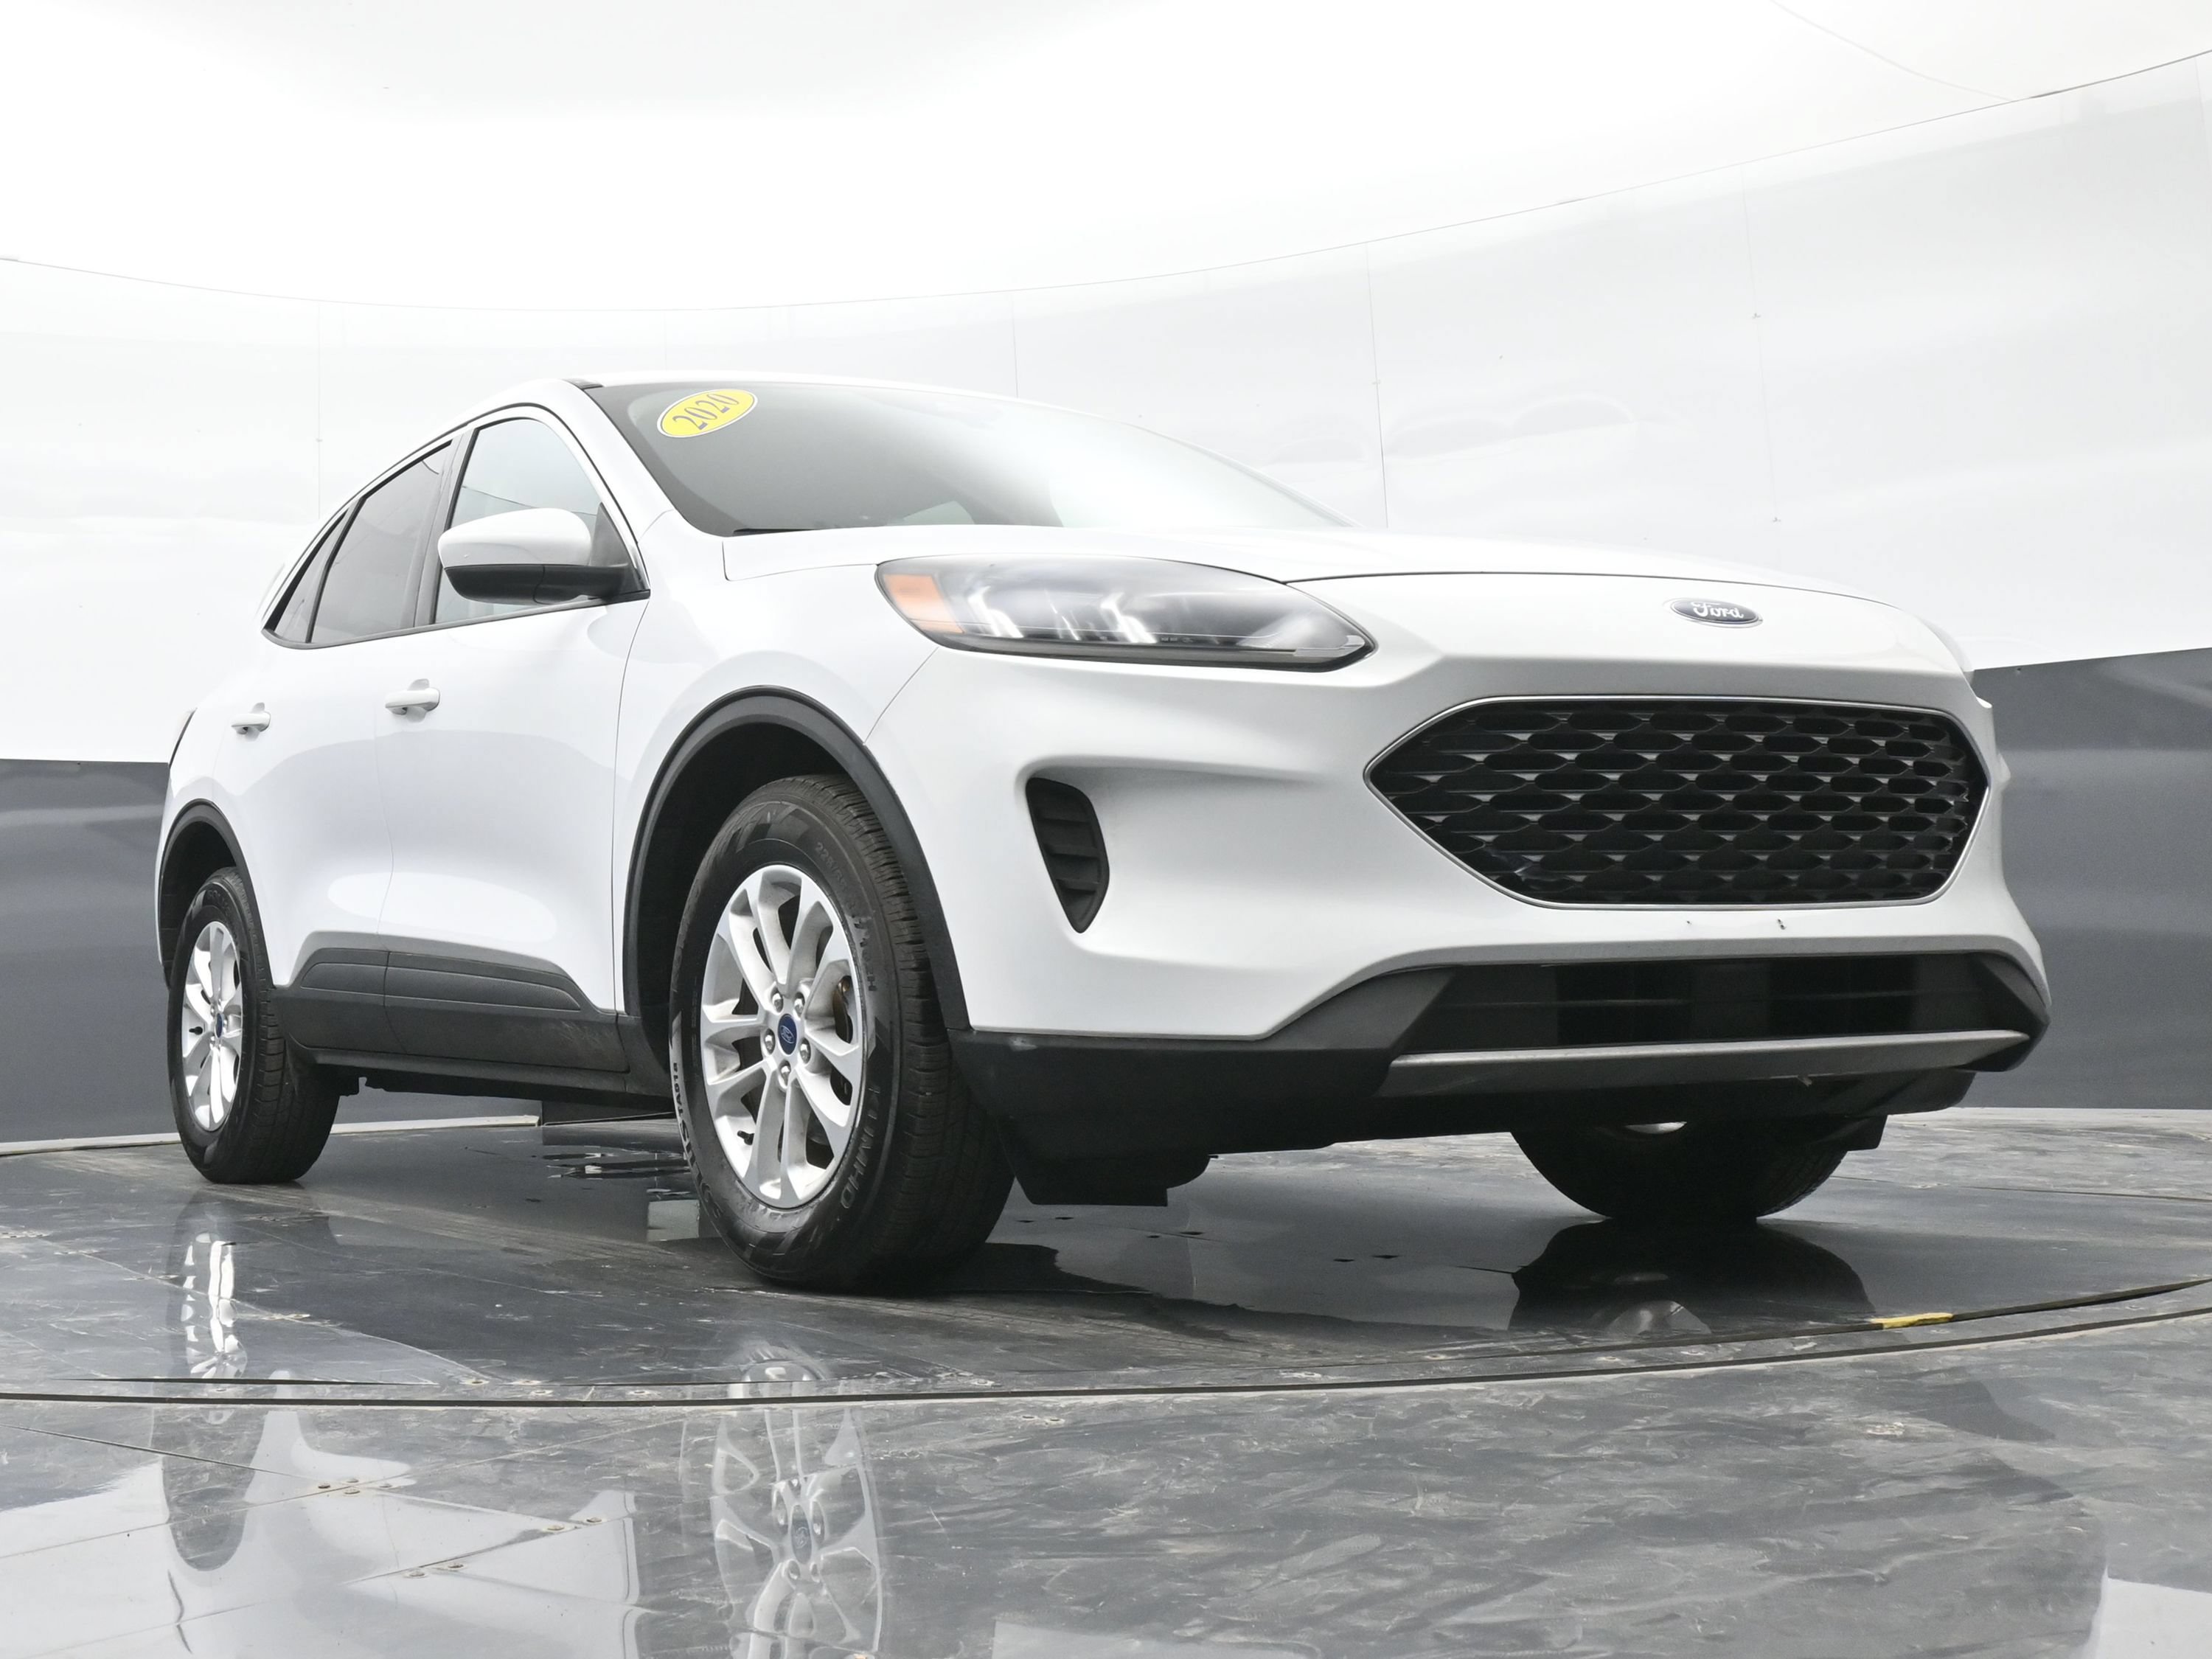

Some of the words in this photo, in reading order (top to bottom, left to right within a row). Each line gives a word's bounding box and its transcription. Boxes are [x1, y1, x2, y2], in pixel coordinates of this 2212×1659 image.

[672, 394, 739, 430] 2020
[1690, 601, 1744, 619] Ford
[840, 1084, 882, 1210] KUMHO
